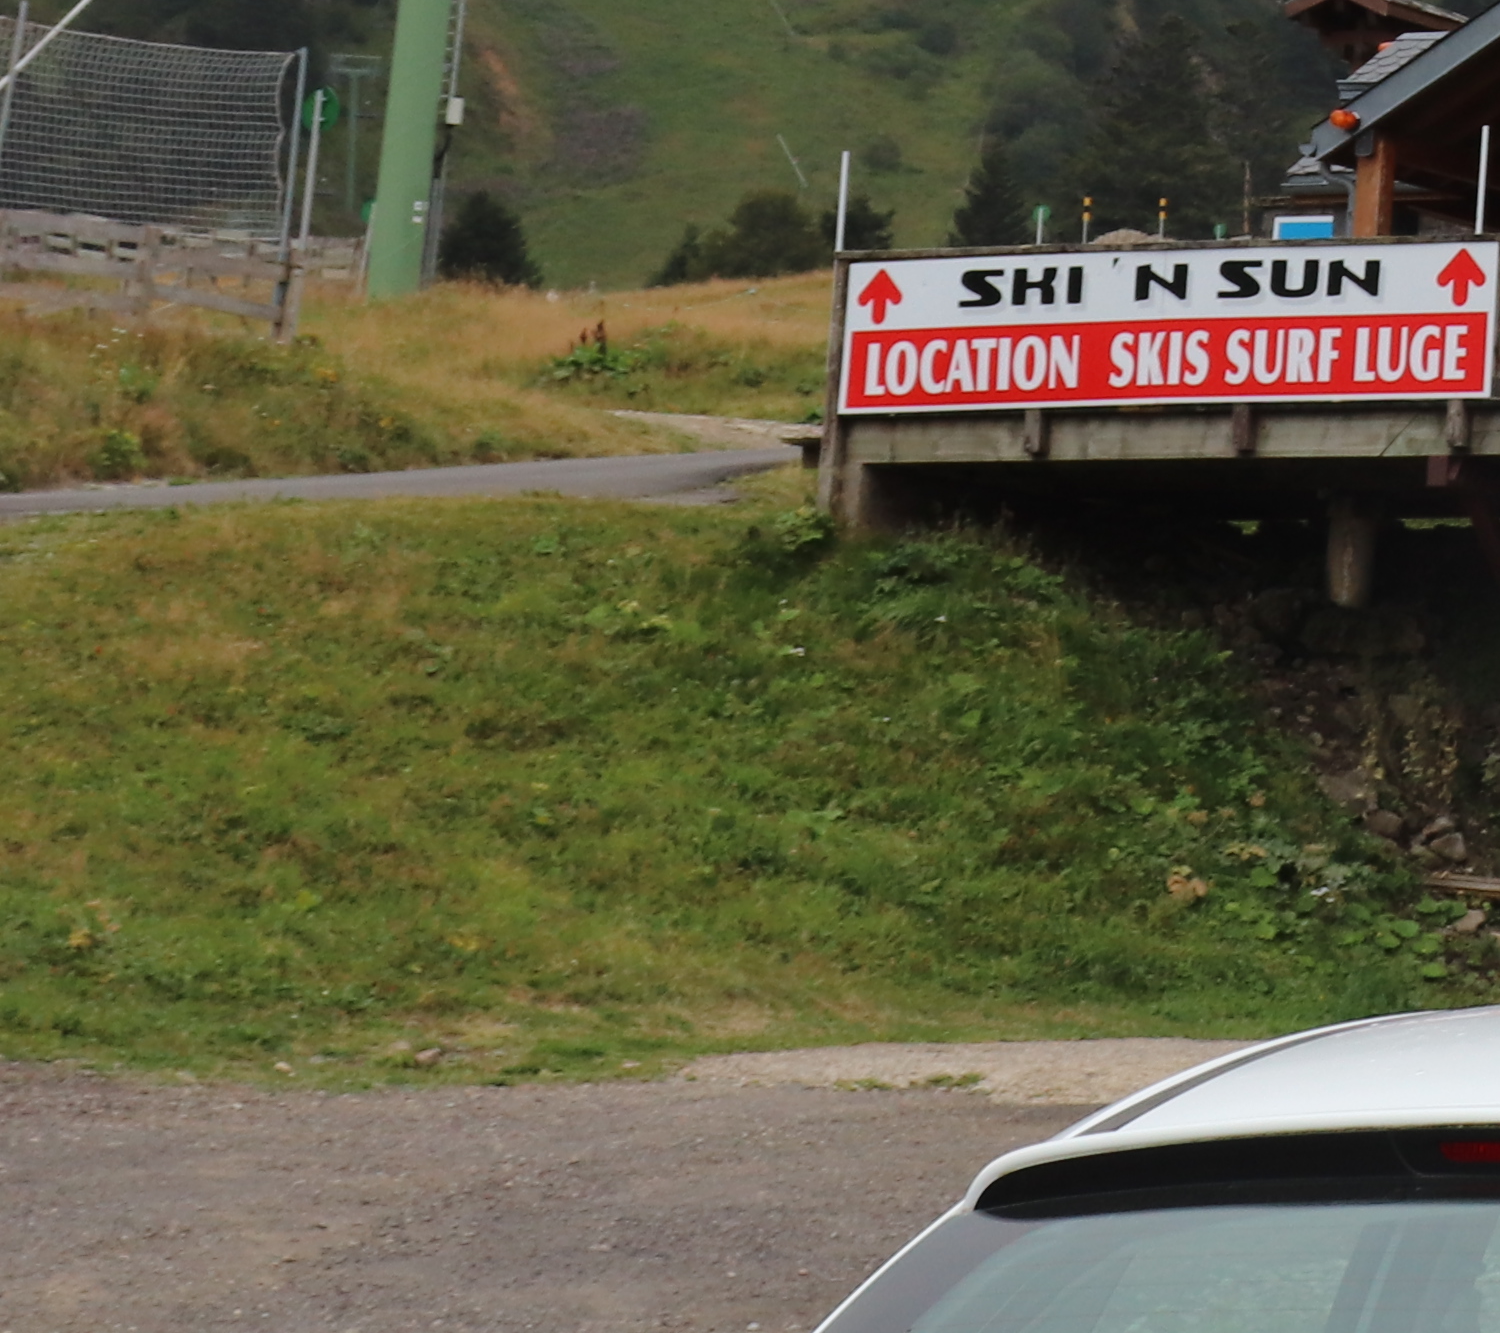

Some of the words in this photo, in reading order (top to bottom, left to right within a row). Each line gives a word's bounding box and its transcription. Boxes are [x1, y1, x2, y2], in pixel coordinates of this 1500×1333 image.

[957, 265, 1085, 308] SKI
[1216, 259, 1382, 299] SUN
[863, 335, 1081, 397] LOCATION
[1107, 330, 1210, 388] SKIS
[1223, 327, 1342, 386] SURF
[1353, 324, 1469, 382] LUGE
